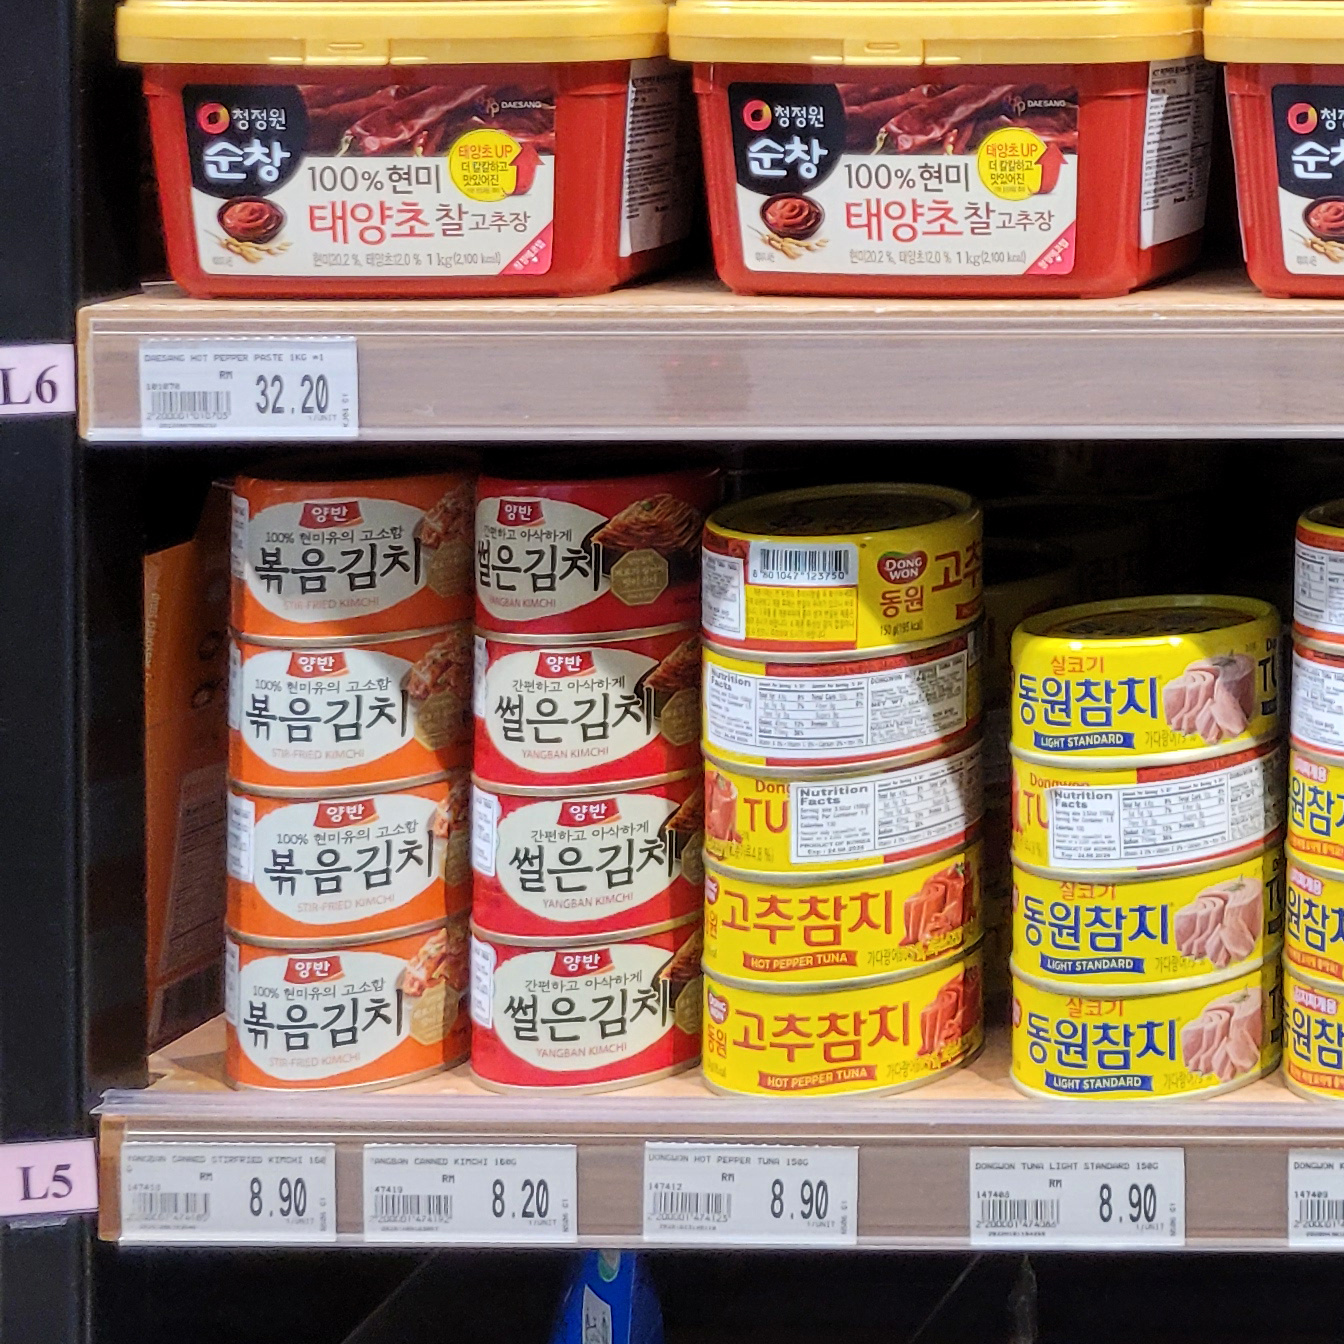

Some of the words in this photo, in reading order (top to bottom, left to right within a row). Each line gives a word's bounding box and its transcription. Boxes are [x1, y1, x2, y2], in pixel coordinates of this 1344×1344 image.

[747, 135, 828, 179] 순창
[0, 364, 58, 405] L6
[255, 373, 329, 416] 32.20
[254, 536, 422, 595] 볶음김치
[885, 556, 923, 571] DONG
[888, 567, 921, 581] WON
[298, 654, 335, 672] 양반
[245, 688, 408, 745] 볶음김치
[494, 685, 653, 743] 썰은김치
[1018, 672, 1159, 727] 동원참치
[1040, 735, 1066, 748] LIGHT
[1067, 732, 1124, 747] STANDARD
[800, 784, 869, 799] Nutrition
[263, 830, 434, 898] 볶음김치
[509, 829, 676, 894] 썰은김치
[541, 896, 593, 910] YANGBAN
[595, 891, 634, 906] KIMCHI
[721, 889, 893, 948] 고추참치
[750, 956, 772, 970] HOT
[772, 954, 813, 970] PEPPER
[816, 952, 848, 965] TUNA
[732, 1000, 910, 1064] 고추참치
[1027, 1011, 1177, 1071] 동원참치
[18, 1163, 74, 1201] L5
[249, 1176, 307, 1219] 8.90
[491, 1178, 549, 1220] 8.20
[770, 1177, 829, 1219] 8.90
[1098, 1182, 1158, 1223] 8.90
